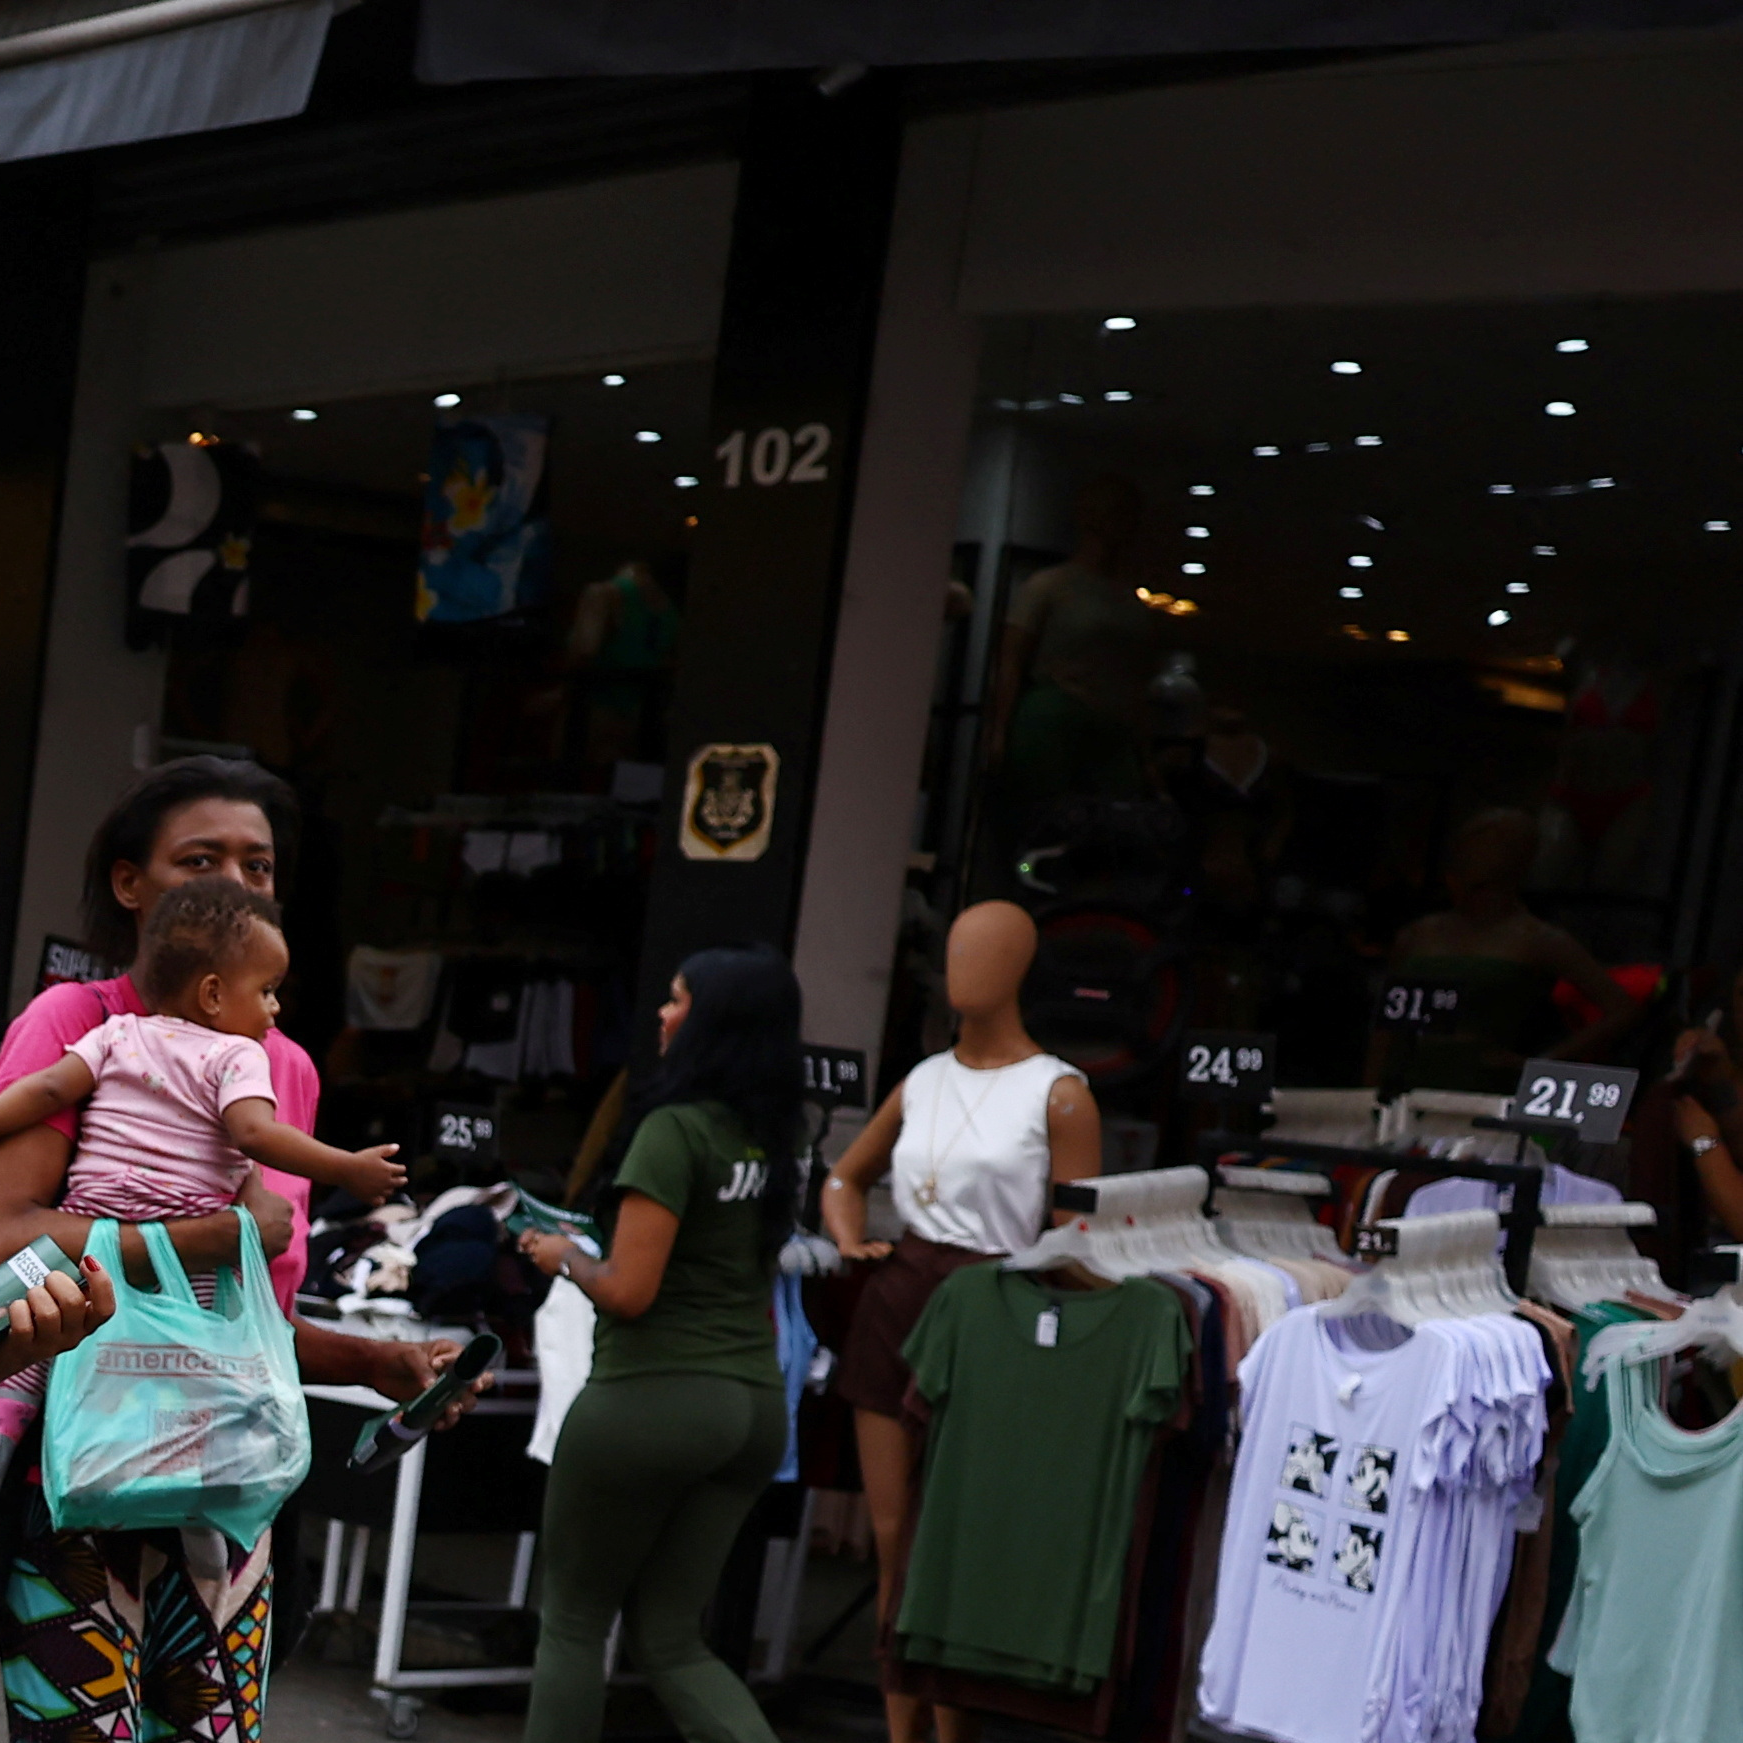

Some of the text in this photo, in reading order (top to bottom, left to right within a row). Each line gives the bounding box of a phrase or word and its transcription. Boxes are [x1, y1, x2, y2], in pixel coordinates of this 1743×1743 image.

[715, 421, 832, 488] 102
[1187, 1044, 1263, 1088] 24,99
[1523, 1076, 1622, 1124] 21,99
